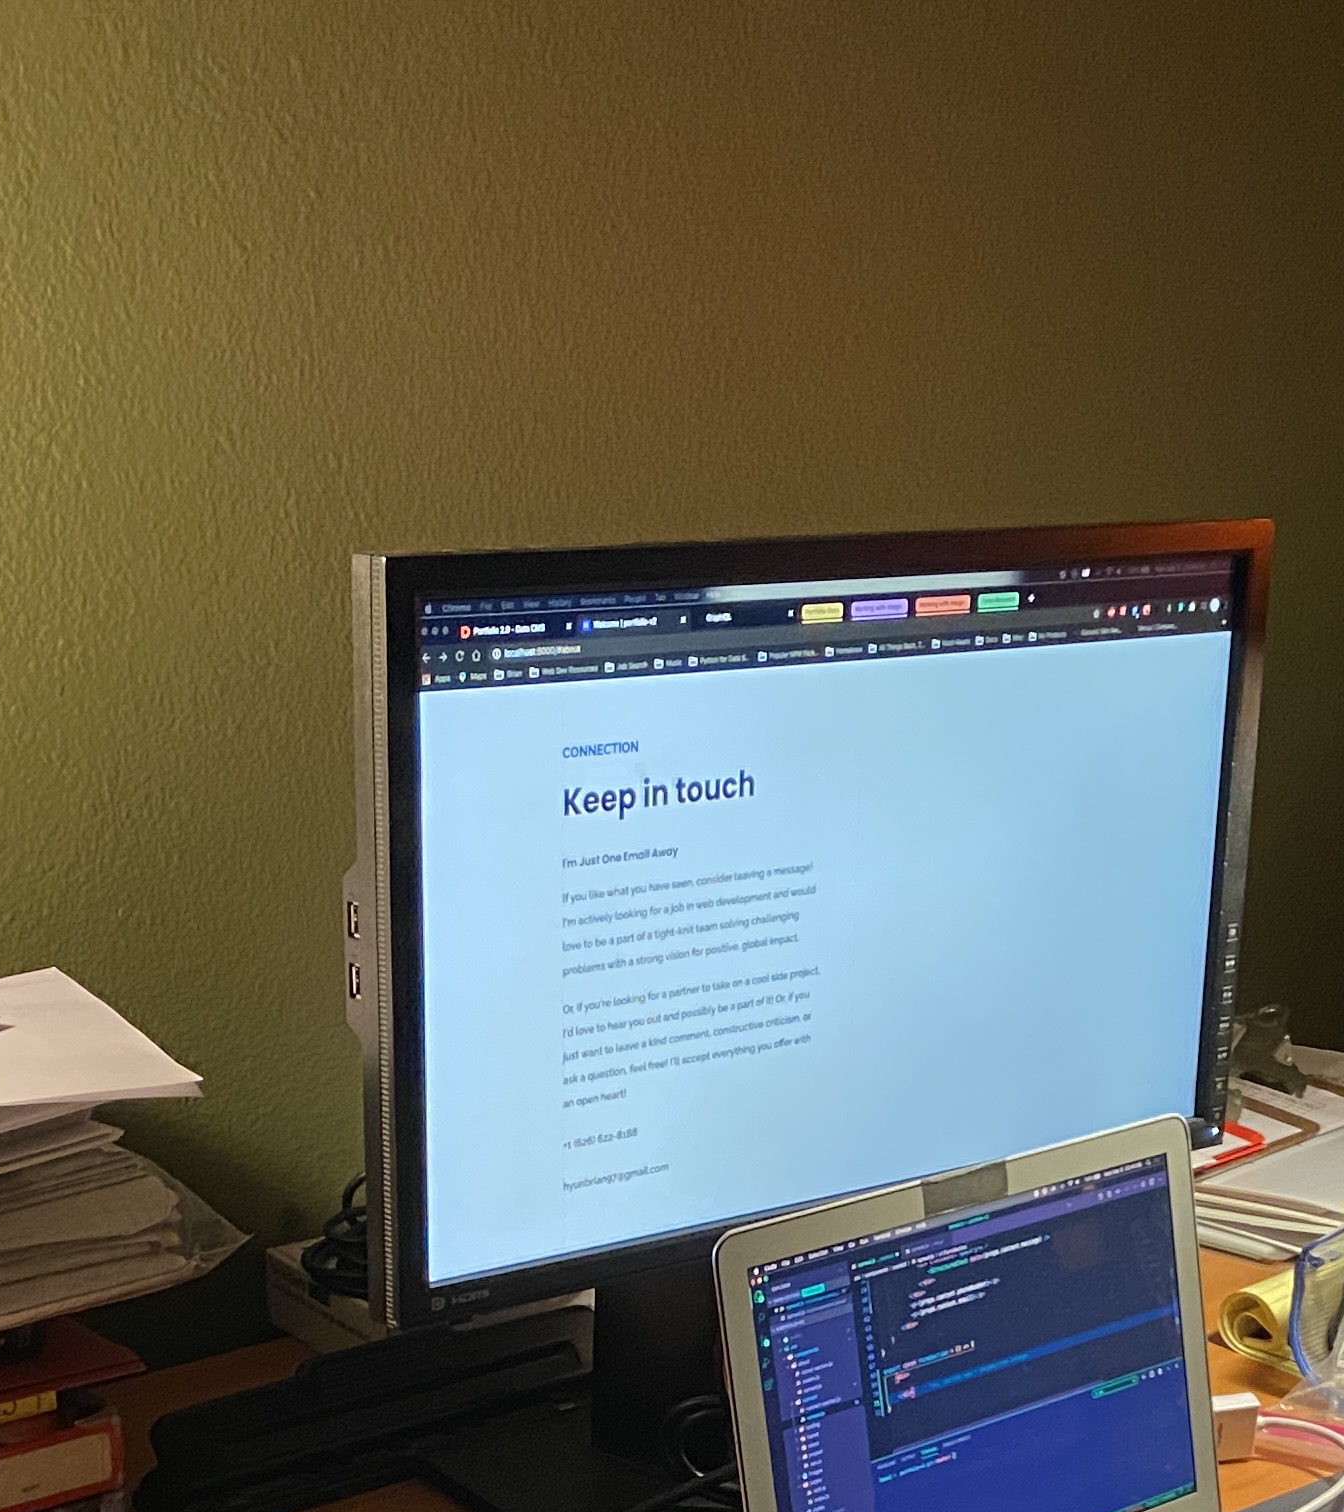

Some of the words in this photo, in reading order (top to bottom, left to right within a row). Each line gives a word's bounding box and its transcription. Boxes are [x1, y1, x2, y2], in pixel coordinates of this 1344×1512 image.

[562, 741, 639, 758] CONNECTION
[563, 787, 636, 820] Keep
[643, 777, 668, 807] in
[675, 769, 755, 804] touch
[562, 857, 577, 868] I'm
[579, 855, 600, 866] Just
[601, 853, 622, 864] One
[623, 848, 650, 861] Email
[651, 847, 679, 858] Away
[570, 893, 587, 905] you
[588, 889, 605, 899] like
[606, 886, 629, 897] what
[630, 885, 647, 897] you
[648, 882, 670, 891] have
[695, 873, 733, 886] consider
[733, 869, 765, 880] leaving
[577, 912, 613, 925] actively
[614, 908, 648, 920] looking
[649, 905, 662, 915] for
[669, 902, 684, 915] job
[695, 898, 714, 909] web
[715, 891, 771, 906] development
[772, 888, 789, 899] and
[789, 884, 816, 896] would
[561, 941, 582, 952] love
[615, 933, 634, 946] part
[653, 925, 694, 940] tight-knit
[695, 922, 718, 933] team
[719, 918, 749, 929] solving
[750, 911, 799, 925] challenging
[562, 962, 605, 978] problems
[606, 958, 626, 969] with
[635, 954, 664, 965] strong
[665, 950, 690, 960] vision
[691, 947, 704, 956] for
[741, 937, 768, 952] global
[612, 994, 646, 1006] looking
[647, 990, 660, 1000] for
[668, 986, 700, 999] partner
[711, 981, 730, 990] take
[751, 973, 770, 984] cool
[770, 972, 788, 982] side
[575, 1025, 594, 1035] love
[606, 1020, 627, 1030] hear
[627, 1018, 645, 1030] you
[646, 1013, 661, 1024] out
[662, 1010, 680, 1021] and
[680, 1005, 716, 1020] possibly
[736, 998, 754, 1011] part
[794, 991, 810, 1003] you
[561, 1050, 579, 1065] just
[581, 1046, 603, 1058] want
[615, 1042, 639, 1052] leave
[648, 1035, 667, 1046] kind
[712, 1021, 764, 1036] constructive
[562, 1073, 578, 1085] ask
[628, 1061, 647, 1073] feel
[681, 1051, 710, 1064] accept
[711, 1045, 756, 1059] everything
[756, 1042, 772, 1054] you
[773, 1037, 792, 1048] offer
[793, 1033, 811, 1044] with
[575, 1095, 599, 1106] open
